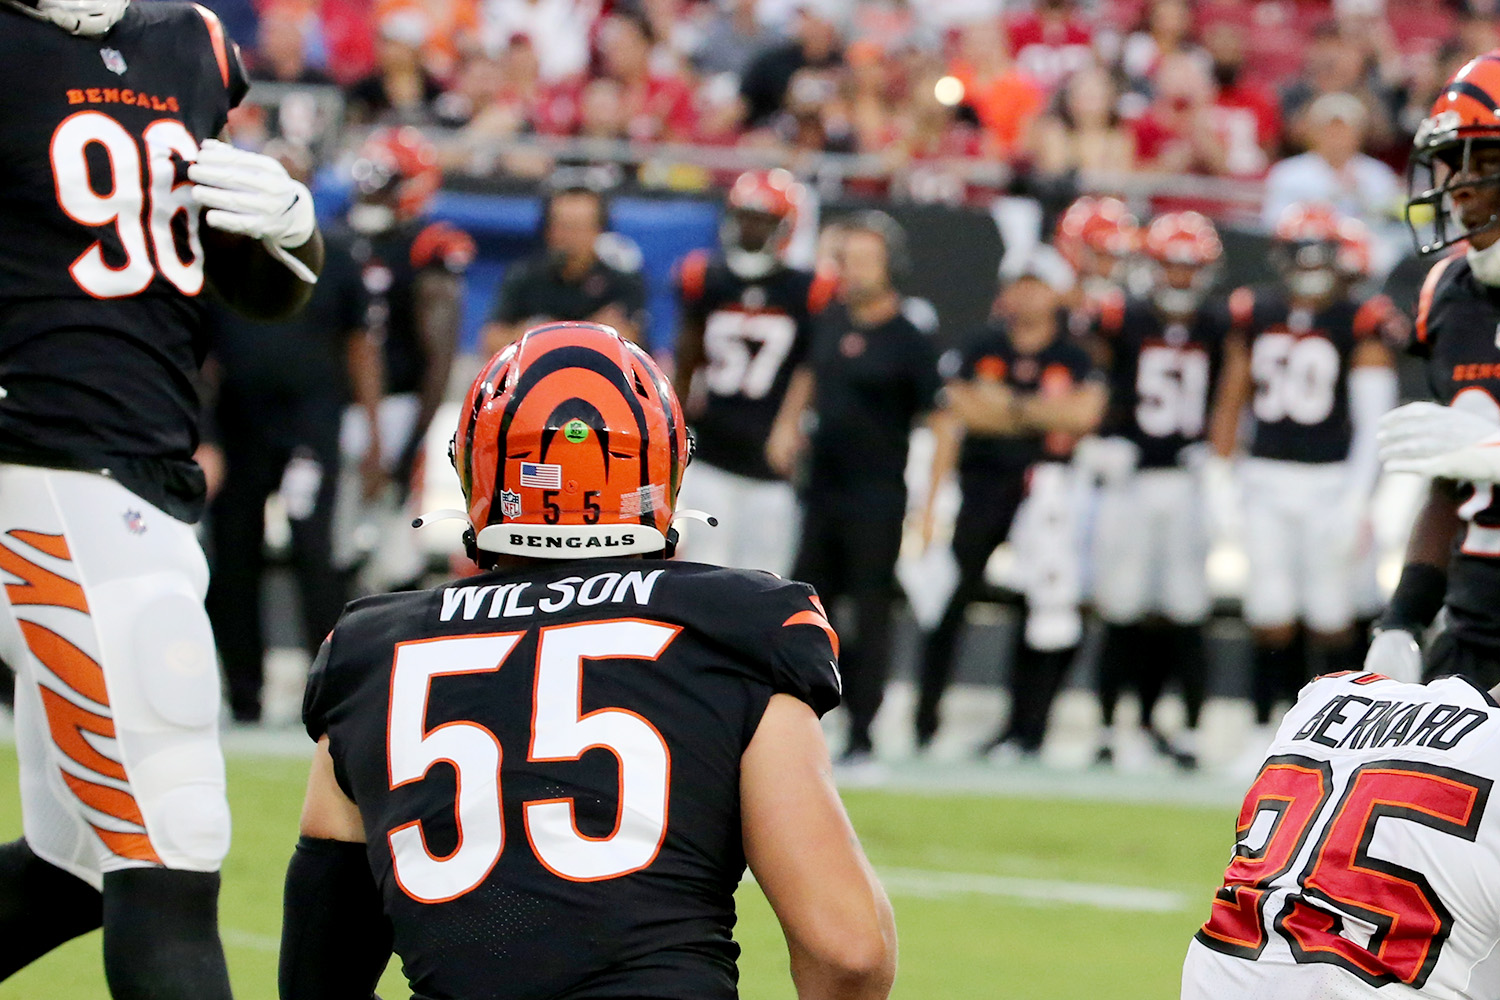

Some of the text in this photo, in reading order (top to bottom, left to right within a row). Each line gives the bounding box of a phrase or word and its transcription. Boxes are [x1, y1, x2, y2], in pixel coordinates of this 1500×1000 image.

[66, 87, 180, 112] BENGALS
[49, 109, 206, 300] 96
[703, 308, 798, 399] 57
[1135, 346, 1210, 438] 51
[1250, 331, 1341, 426] 50
[503, 502, 520, 516] NFL
[509, 534, 636, 549] BENGALS
[439, 569, 666, 622] WILSON
[387, 616, 684, 904] 55
[1292, 694, 1489, 750] BERNARD
[1193, 753, 1495, 990] 25
